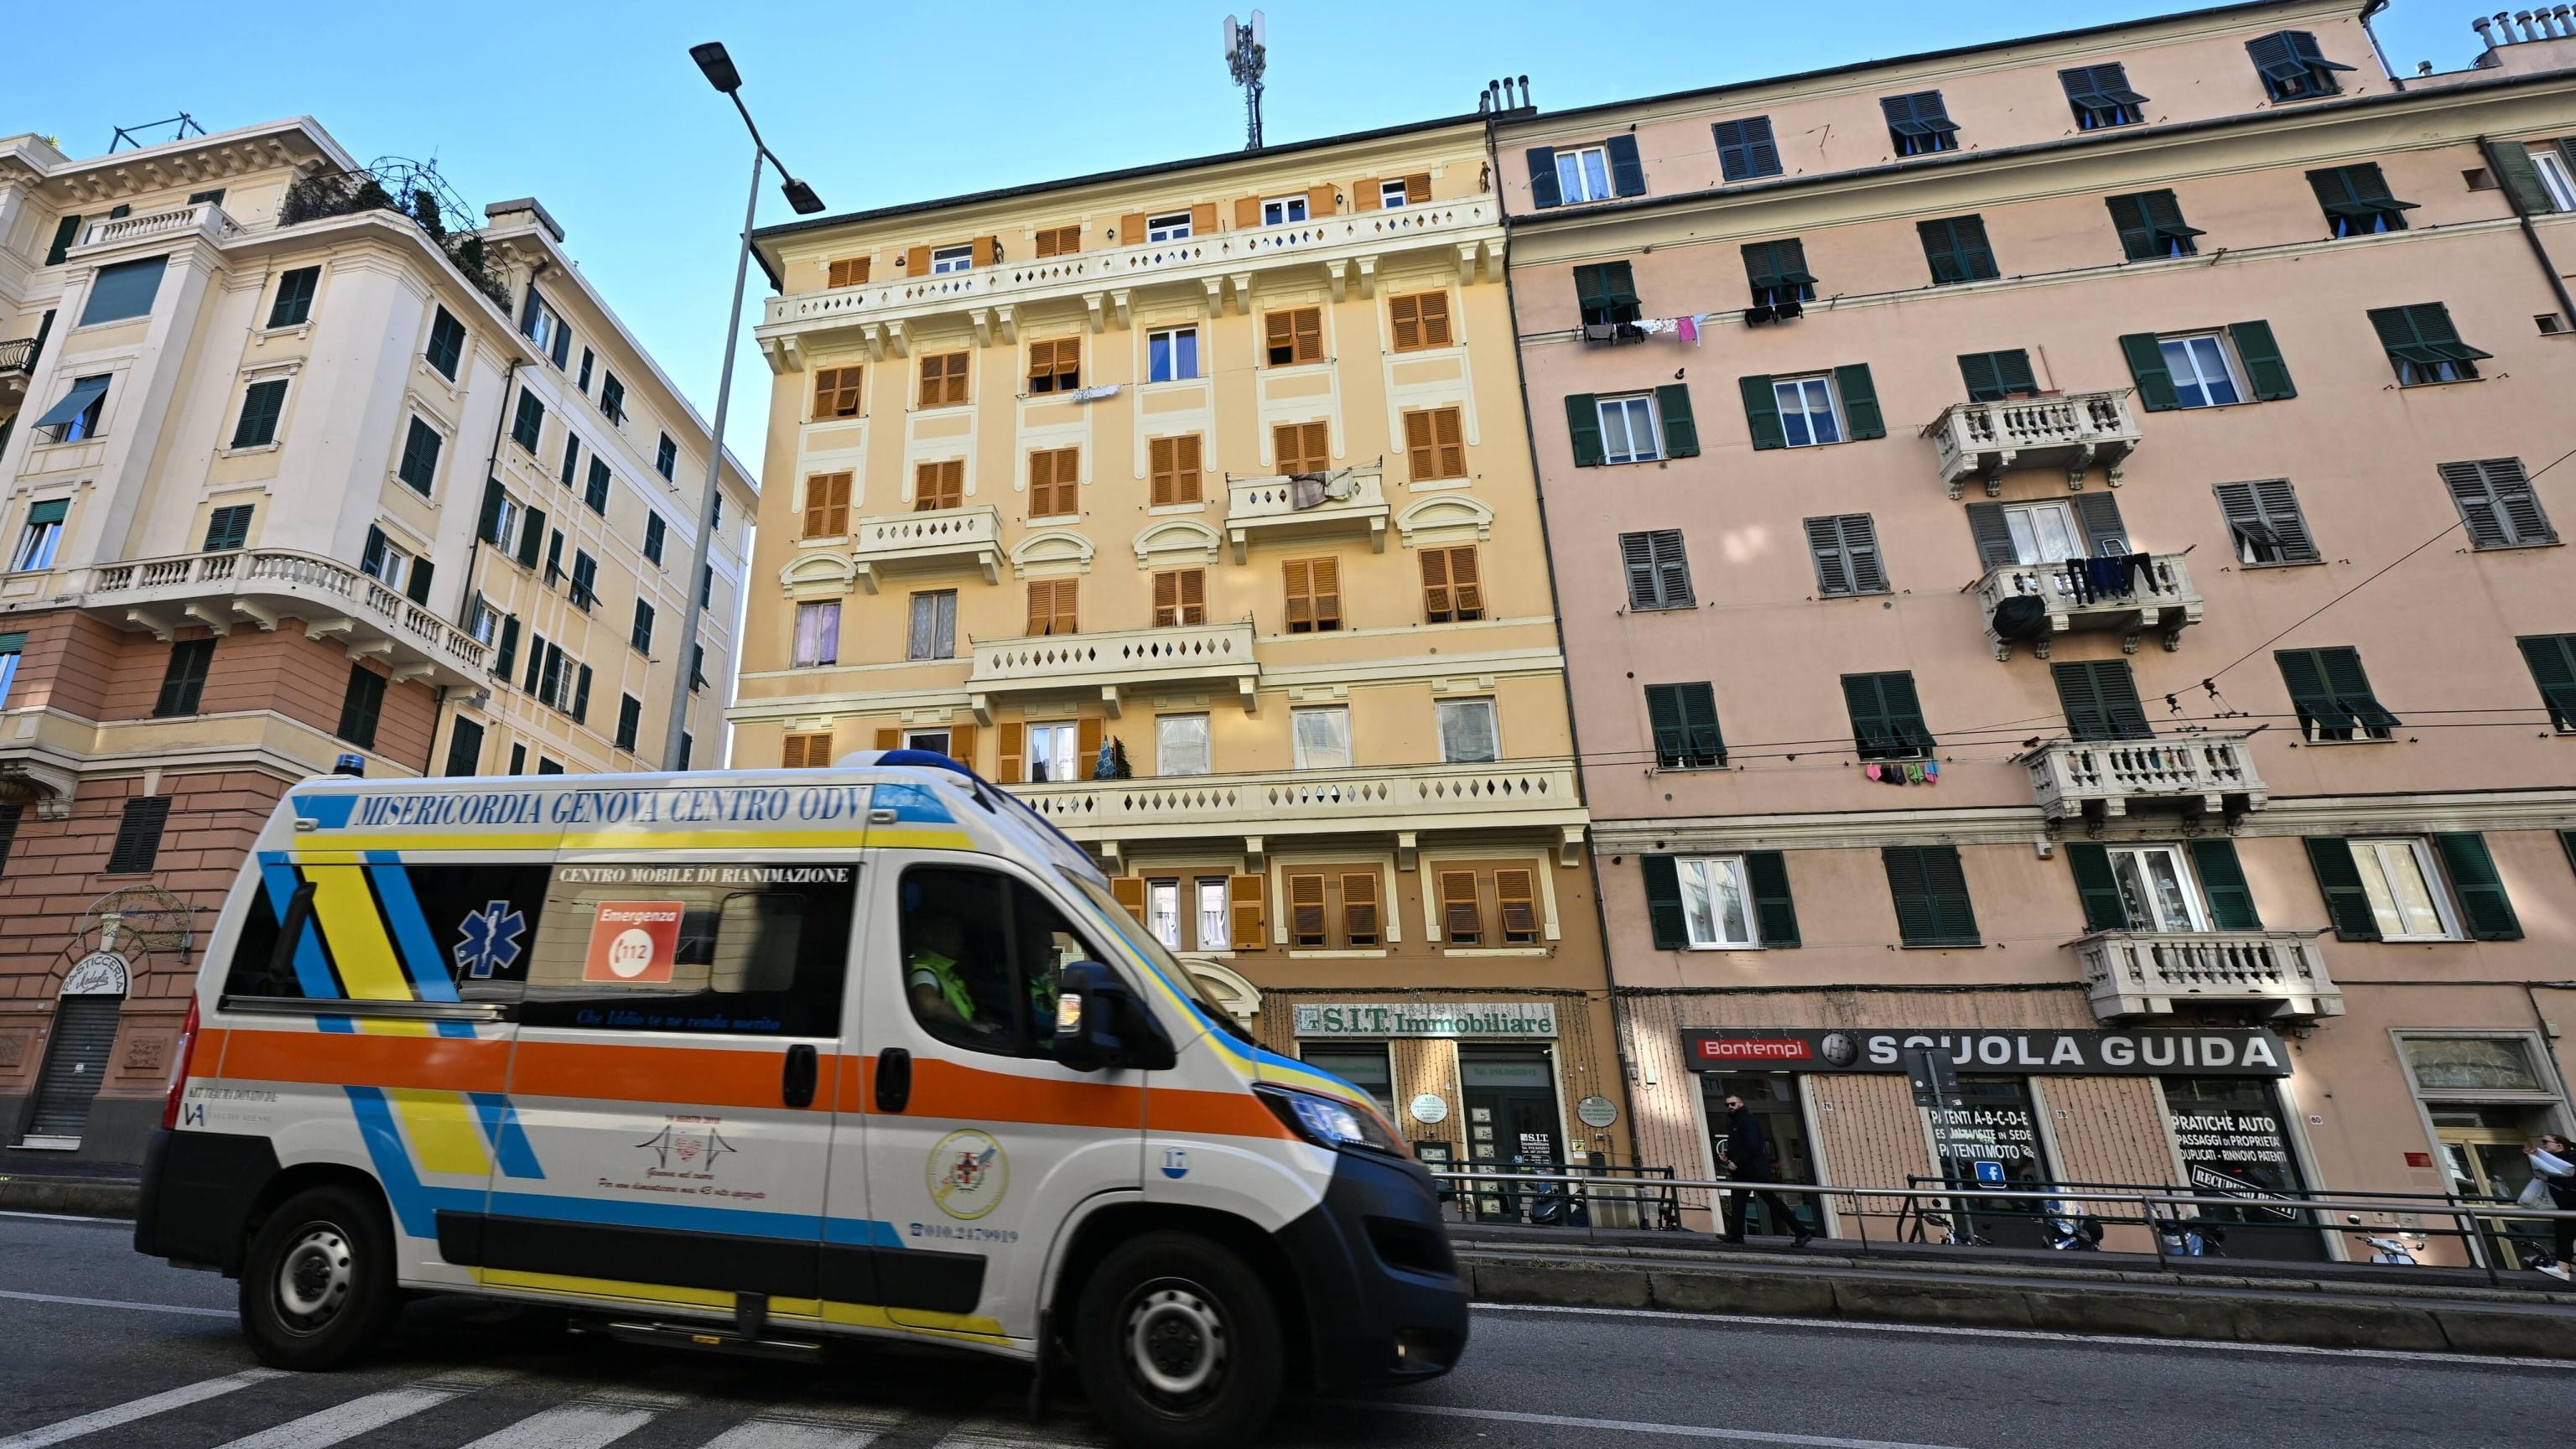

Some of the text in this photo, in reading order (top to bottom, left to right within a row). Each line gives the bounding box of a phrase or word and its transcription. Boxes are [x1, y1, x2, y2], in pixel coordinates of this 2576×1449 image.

[354, 792, 541, 826] MISERICORDIA
[551, 791, 658, 823] GENOVA
[670, 788, 790, 822] CENTRO
[798, 787, 867, 820] ODV
[559, 868, 849, 883] CENTRO MOBILE DI RIANIMAZIONE
[600, 908, 677, 925] Emergenza
[621, 943, 647, 960] 112
[61, 956, 124, 992] PASTICCERIA
[576, 1010, 602, 1025] Che
[1323, 1007, 1552, 1033] S.I.T. Immobiliare
[1705, 1041, 1803, 1058] Bontempi
[2100, 1036, 2278, 1067] GUIDA
[1974, 1111, 2028, 1125] A-B-C-D-E
[2171, 1116, 2276, 1132] PRATICHE AUTO
[1528, 1133, 1550, 1142] S.I.T.
[1998, 1131, 2007, 1140] IN
[2010, 1130, 2033, 1140] SEDE
[2177, 1134, 2222, 1145] PASSAGGI
[2222, 1138, 2231, 1146] DI
[1986, 1144, 2020, 1159] MOTO
[2179, 1150, 2216, 1161] DUPLICATI
[2222, 1150, 2257, 1161] RINNOVO
[2258, 1151, 2287, 1162] PATENTI
